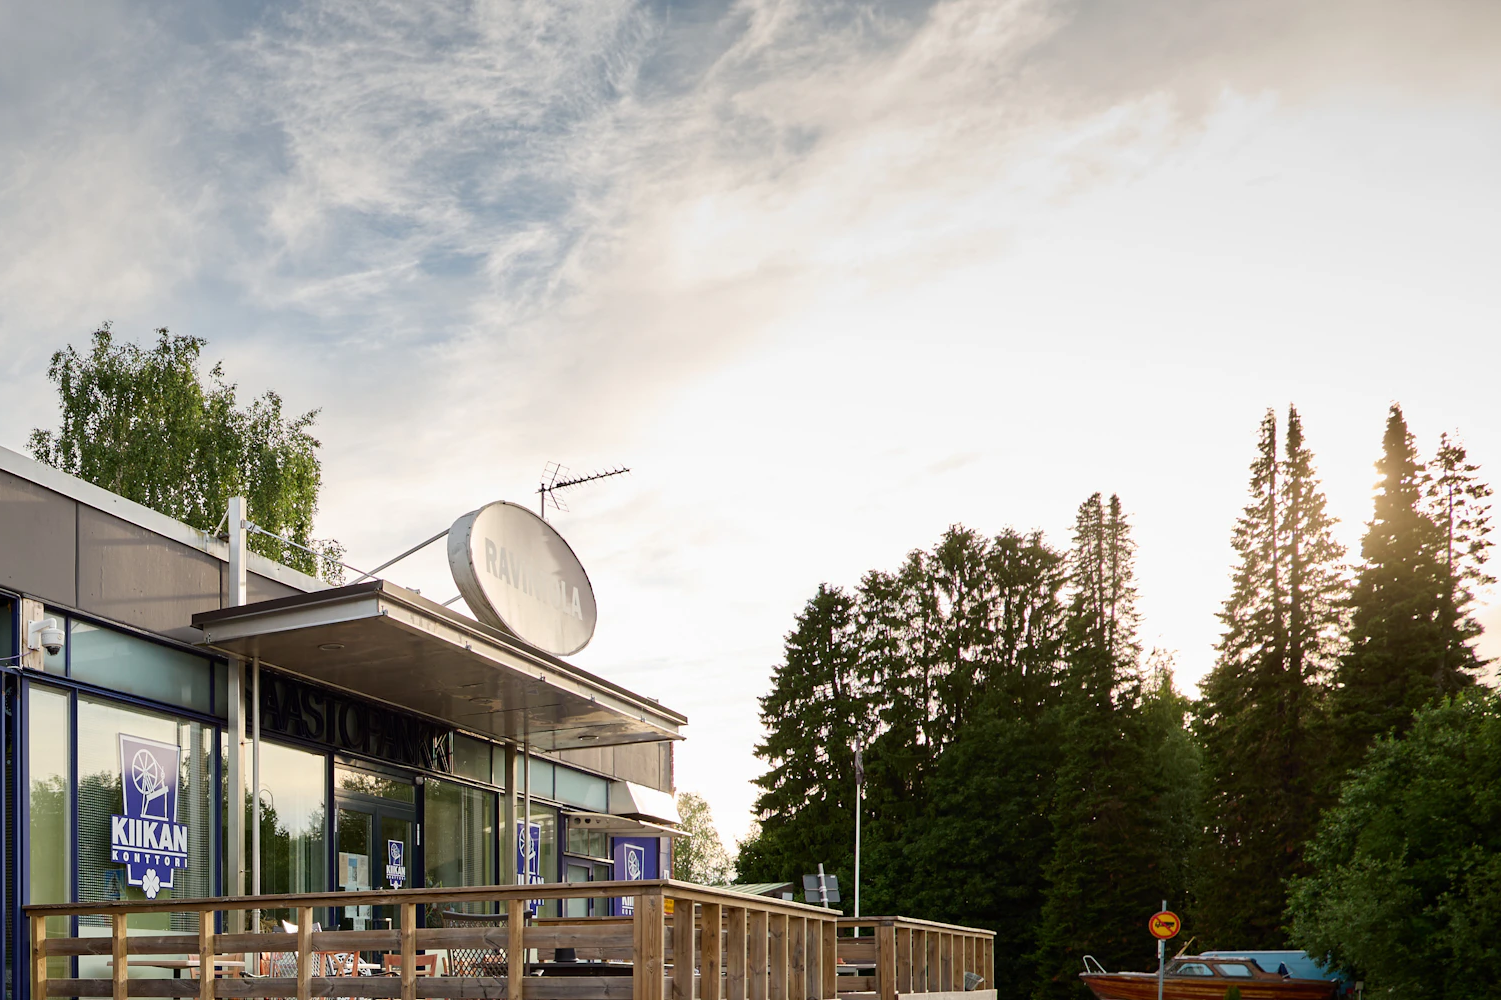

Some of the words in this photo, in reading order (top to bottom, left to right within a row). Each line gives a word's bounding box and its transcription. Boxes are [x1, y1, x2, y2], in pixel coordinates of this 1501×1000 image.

[484, 537, 583, 621] RAVIOLA
[112, 815, 188, 853] KIIKAN
[112, 850, 188, 868] KONTTORI
